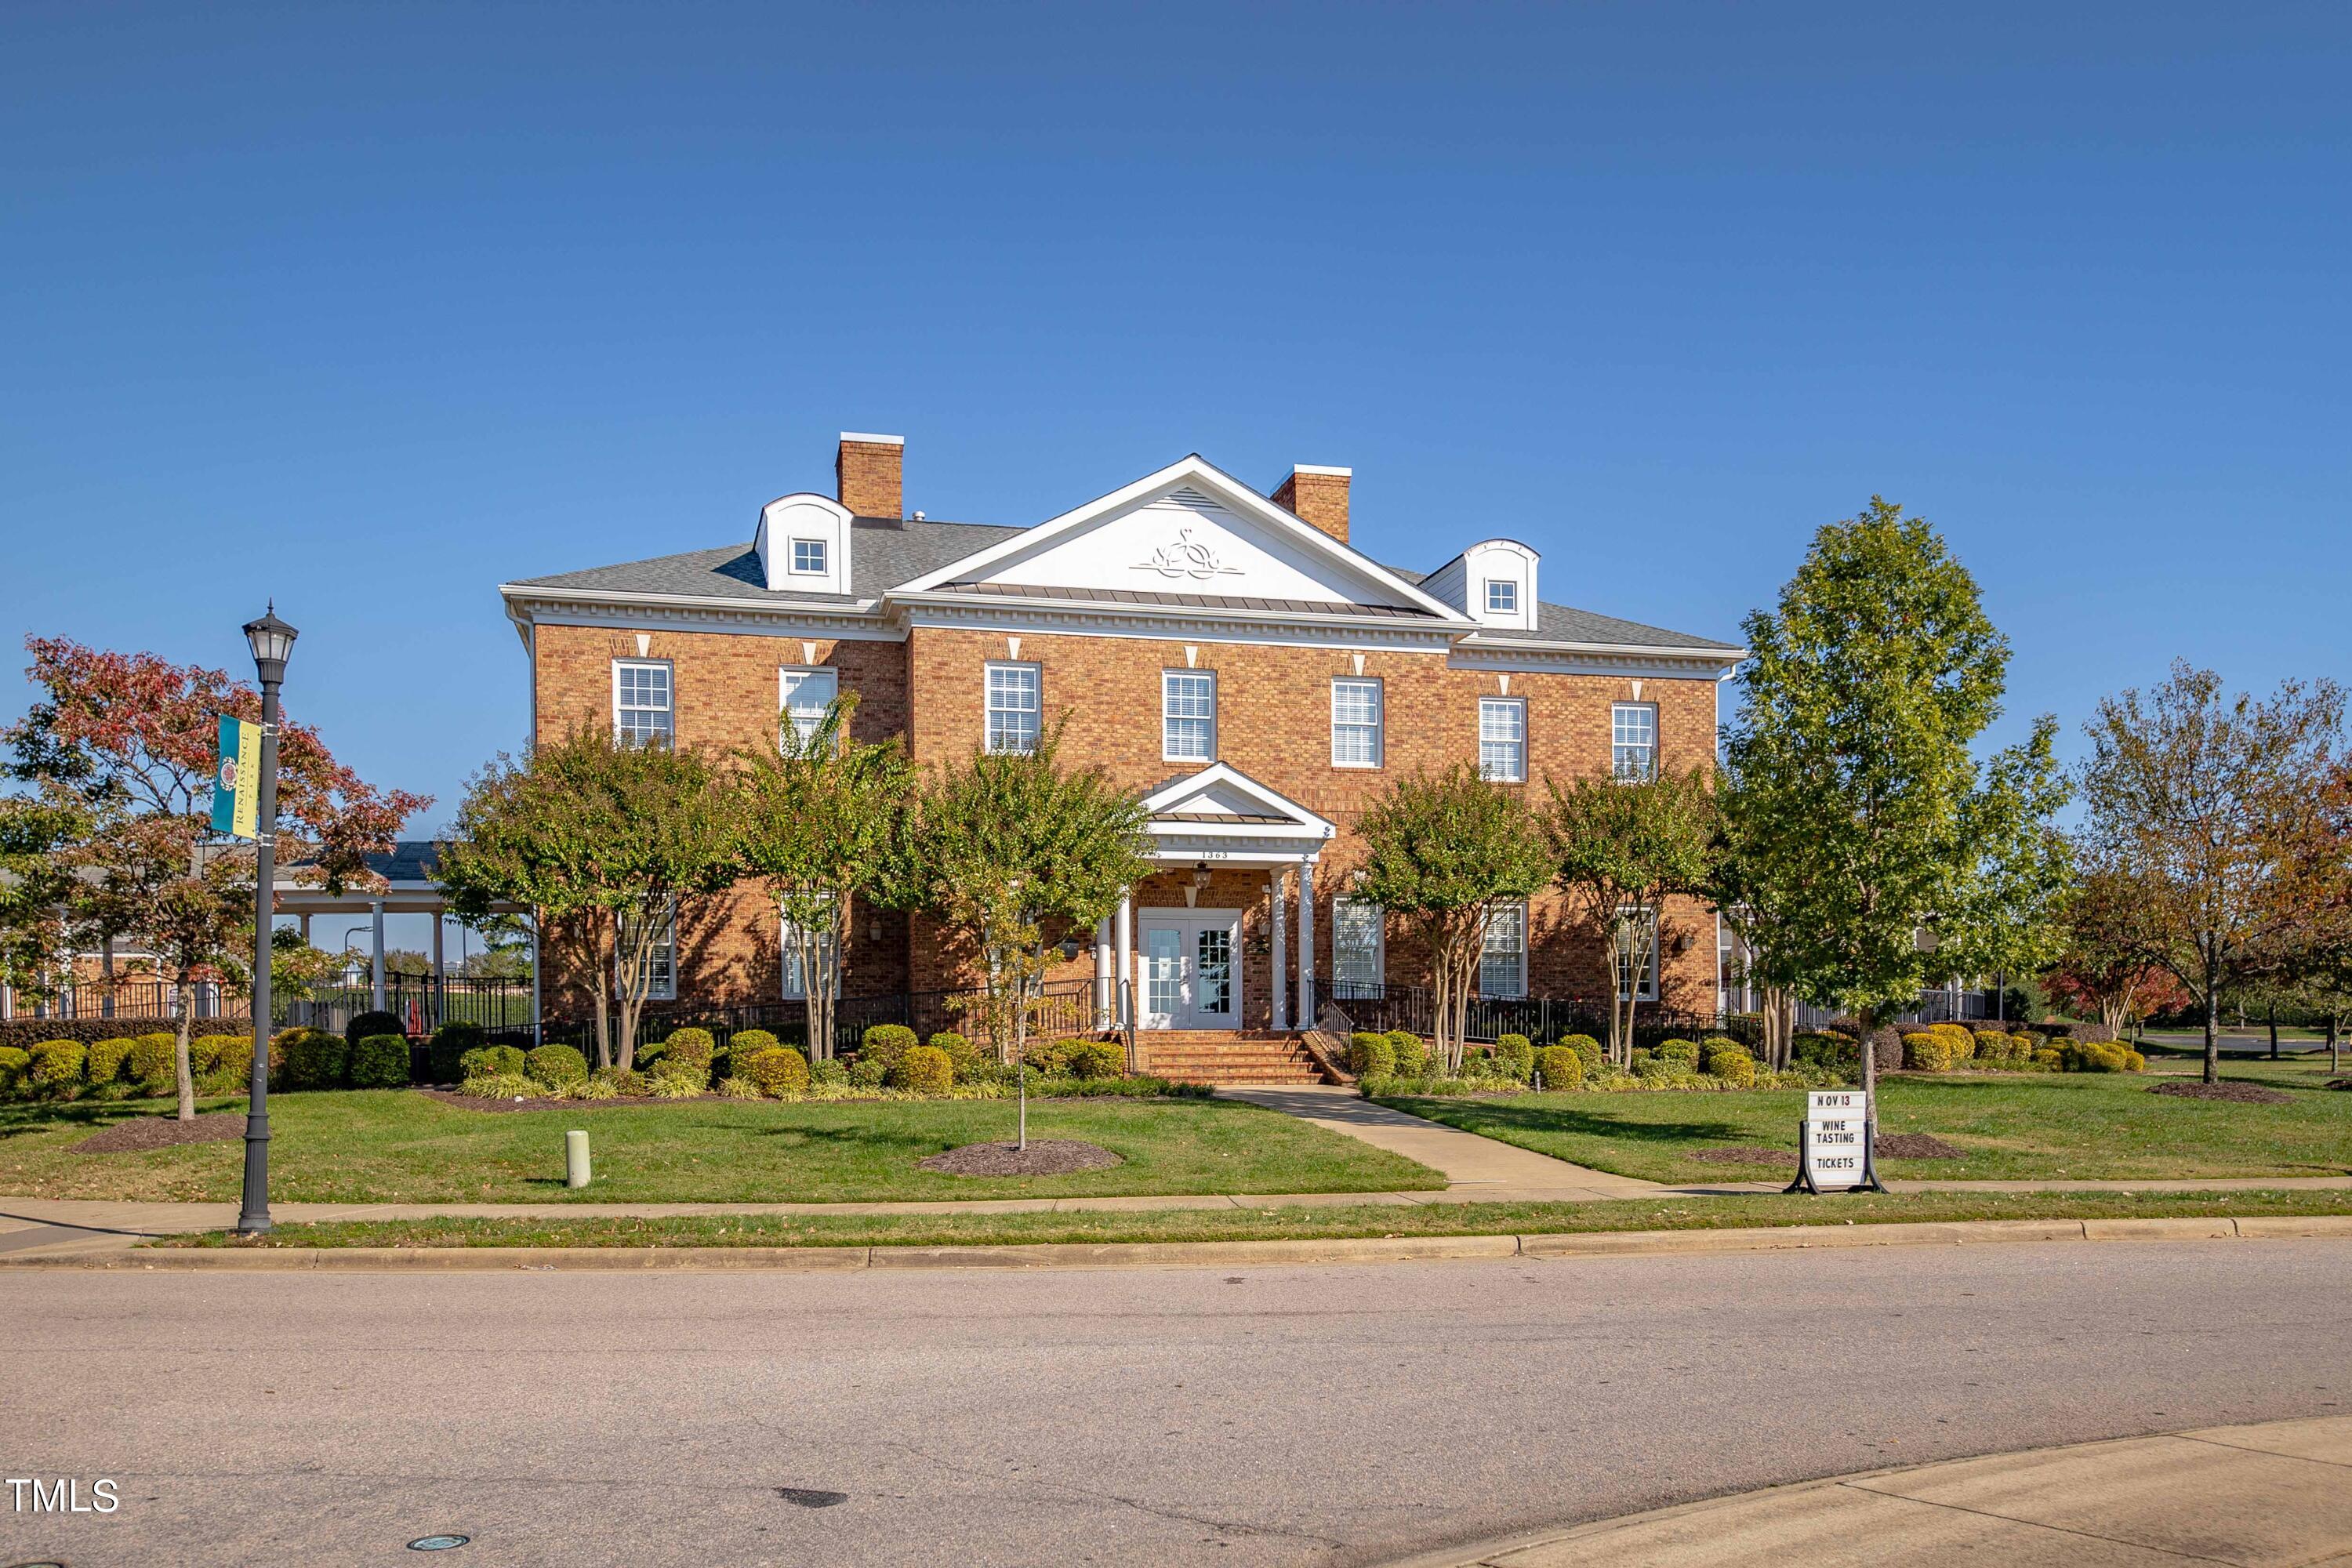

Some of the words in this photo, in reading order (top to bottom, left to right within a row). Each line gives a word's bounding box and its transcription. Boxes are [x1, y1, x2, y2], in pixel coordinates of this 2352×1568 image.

[236, 731, 249, 824] RENAISSANCE
[1817, 1096, 1838, 1106] NOV
[1842, 1096, 1850, 1106] 13
[1822, 1120, 1846, 1131] WINE
[1817, 1133, 1855, 1143] TASTING
[1817, 1158, 1854, 1168] TICKETS
